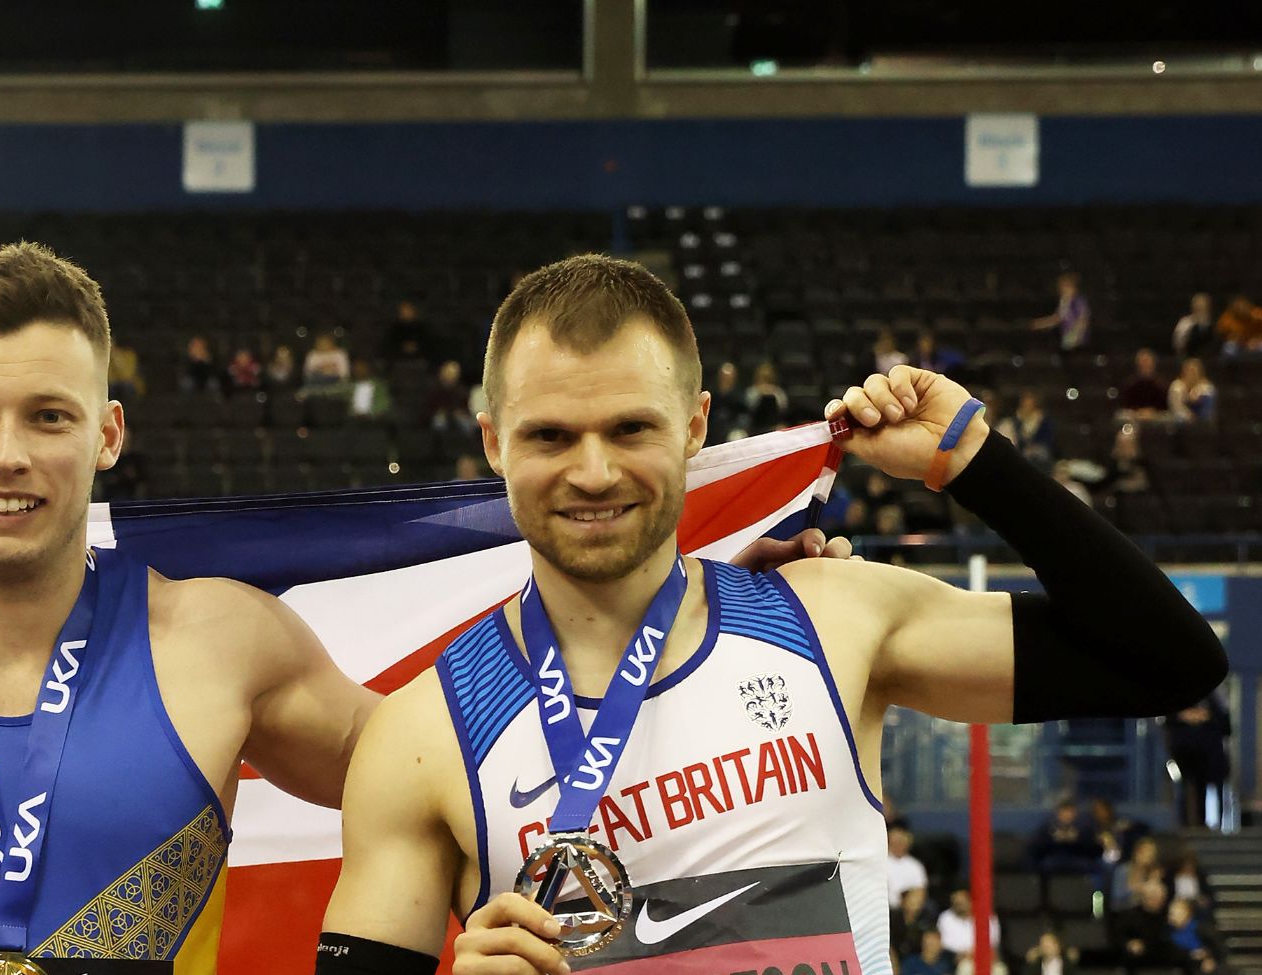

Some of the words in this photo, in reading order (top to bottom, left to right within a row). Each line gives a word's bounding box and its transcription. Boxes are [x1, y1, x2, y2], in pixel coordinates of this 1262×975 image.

[40, 639, 87, 714] UKA
[538, 646, 571, 725] UKA
[620, 625, 664, 686] UKA
[571, 736, 621, 790] UKA
[656, 732, 827, 831] BRITAIN
[4, 791, 47, 882] UKA
